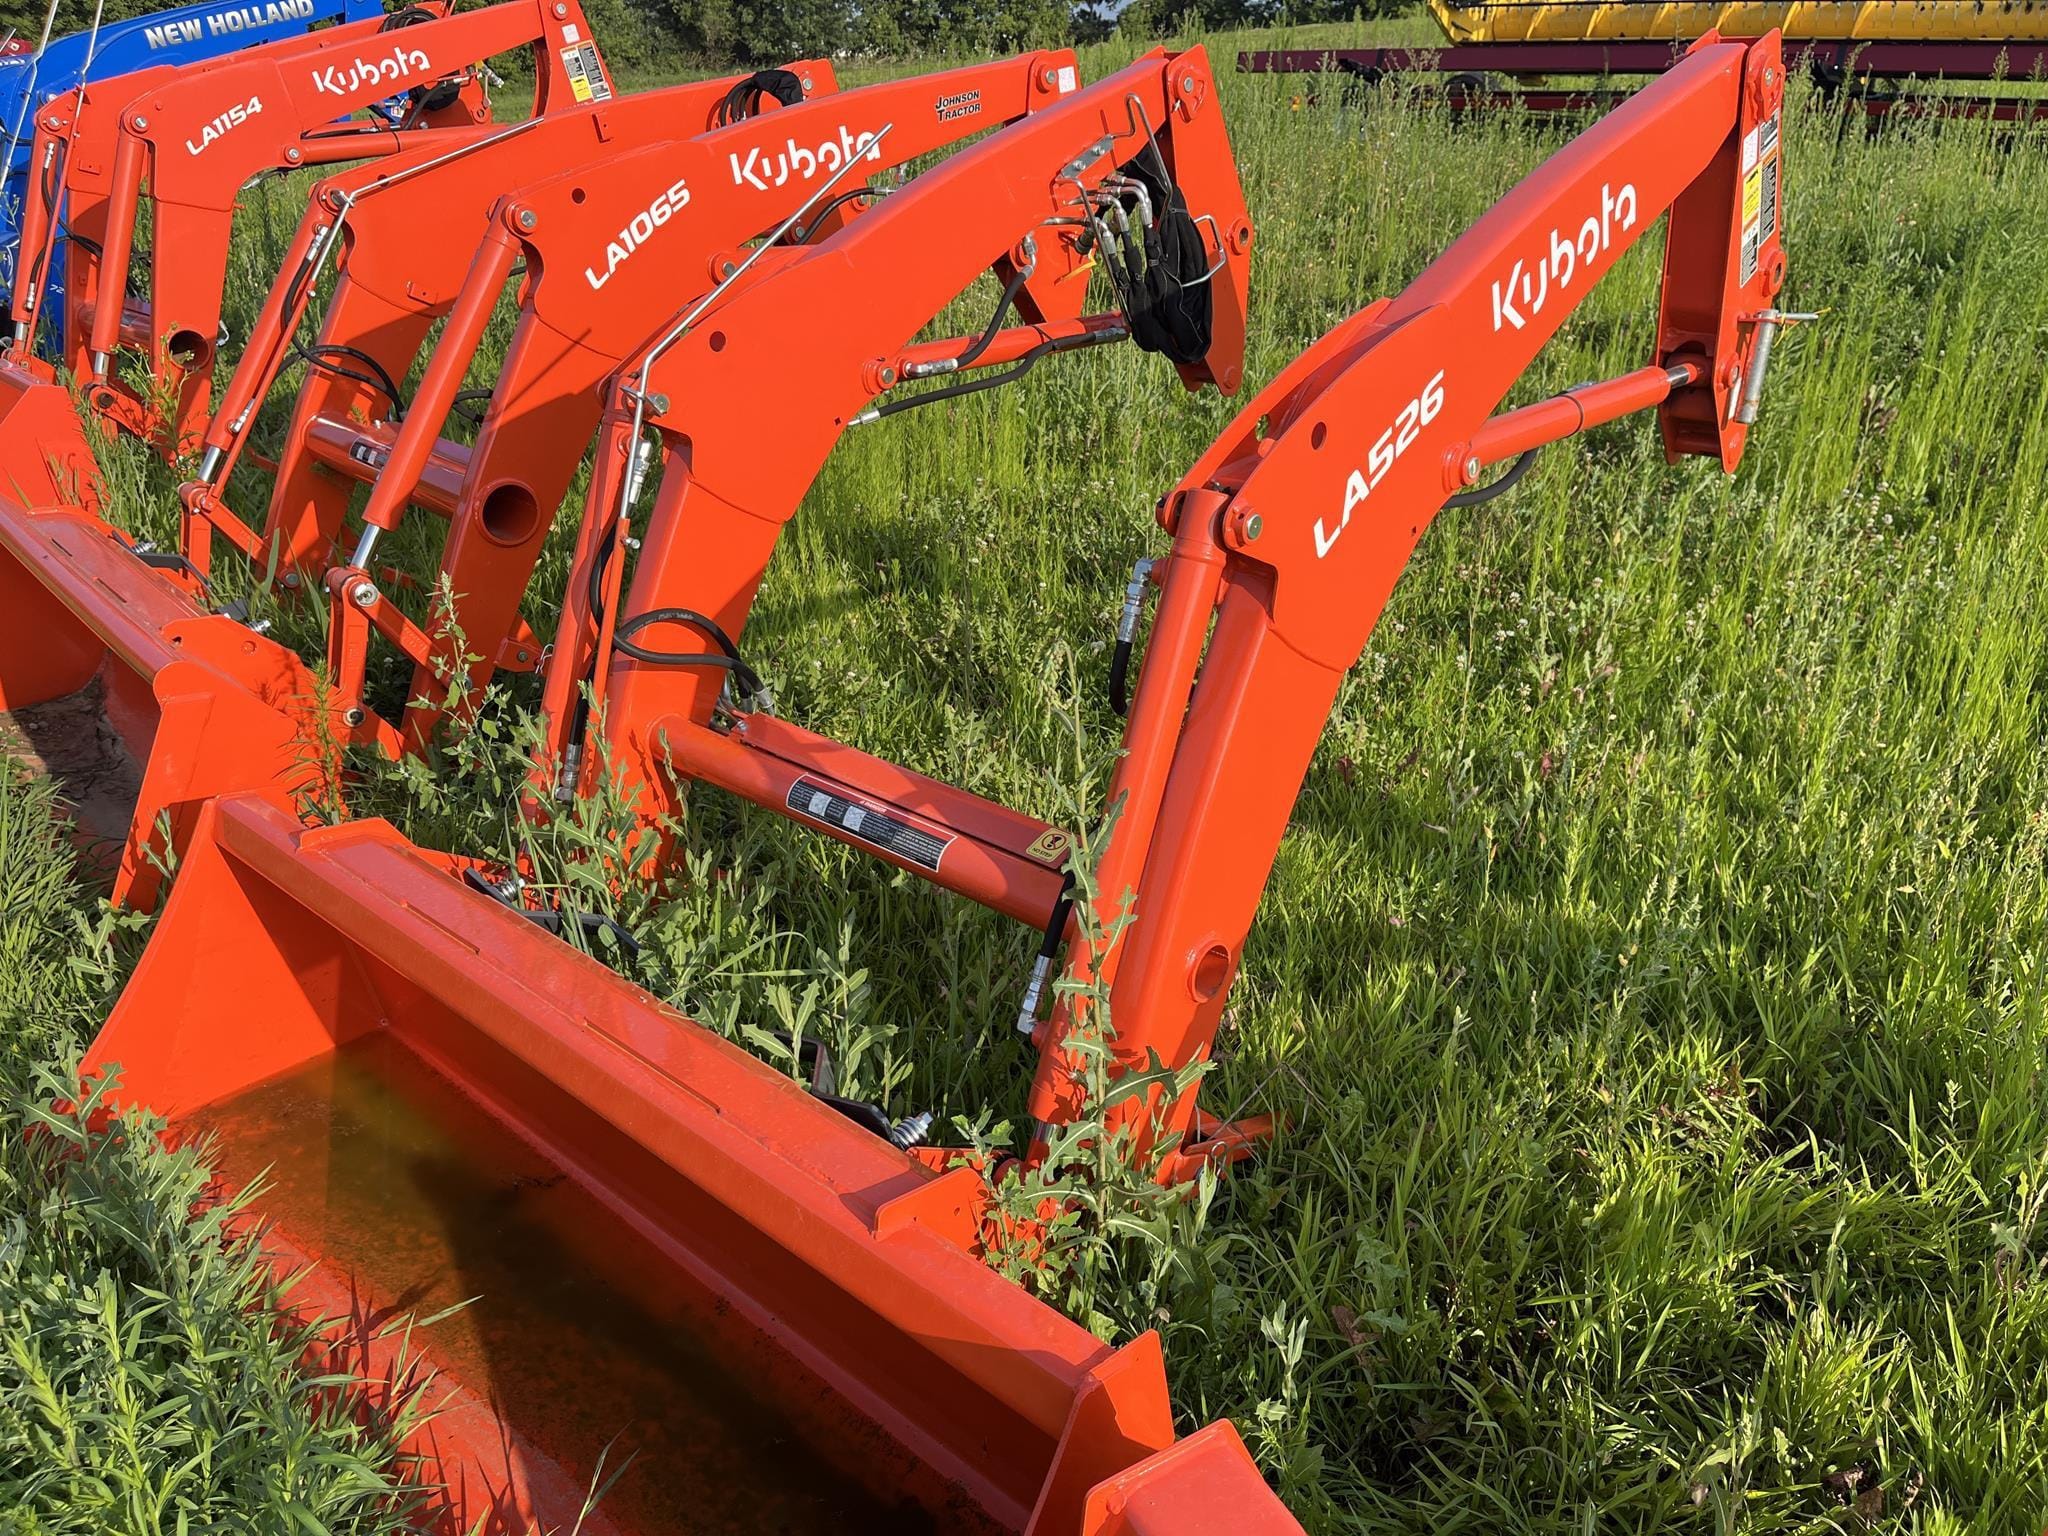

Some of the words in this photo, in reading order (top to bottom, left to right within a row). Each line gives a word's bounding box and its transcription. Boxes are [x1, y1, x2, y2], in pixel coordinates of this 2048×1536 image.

[144, 18, 203, 50] NEW
[206, 0, 314, 36] HOLLAND
[311, 46, 431, 96] Kubota
[935, 90, 980, 109] JOHNSON
[185, 95, 264, 157] LA1154
[937, 103, 981, 122] TRACTOR
[729, 124, 882, 191] Kubota
[584, 178, 691, 290] LA1065
[1491, 183, 1638, 332] Kubota
[1313, 369, 1445, 559] LA526
